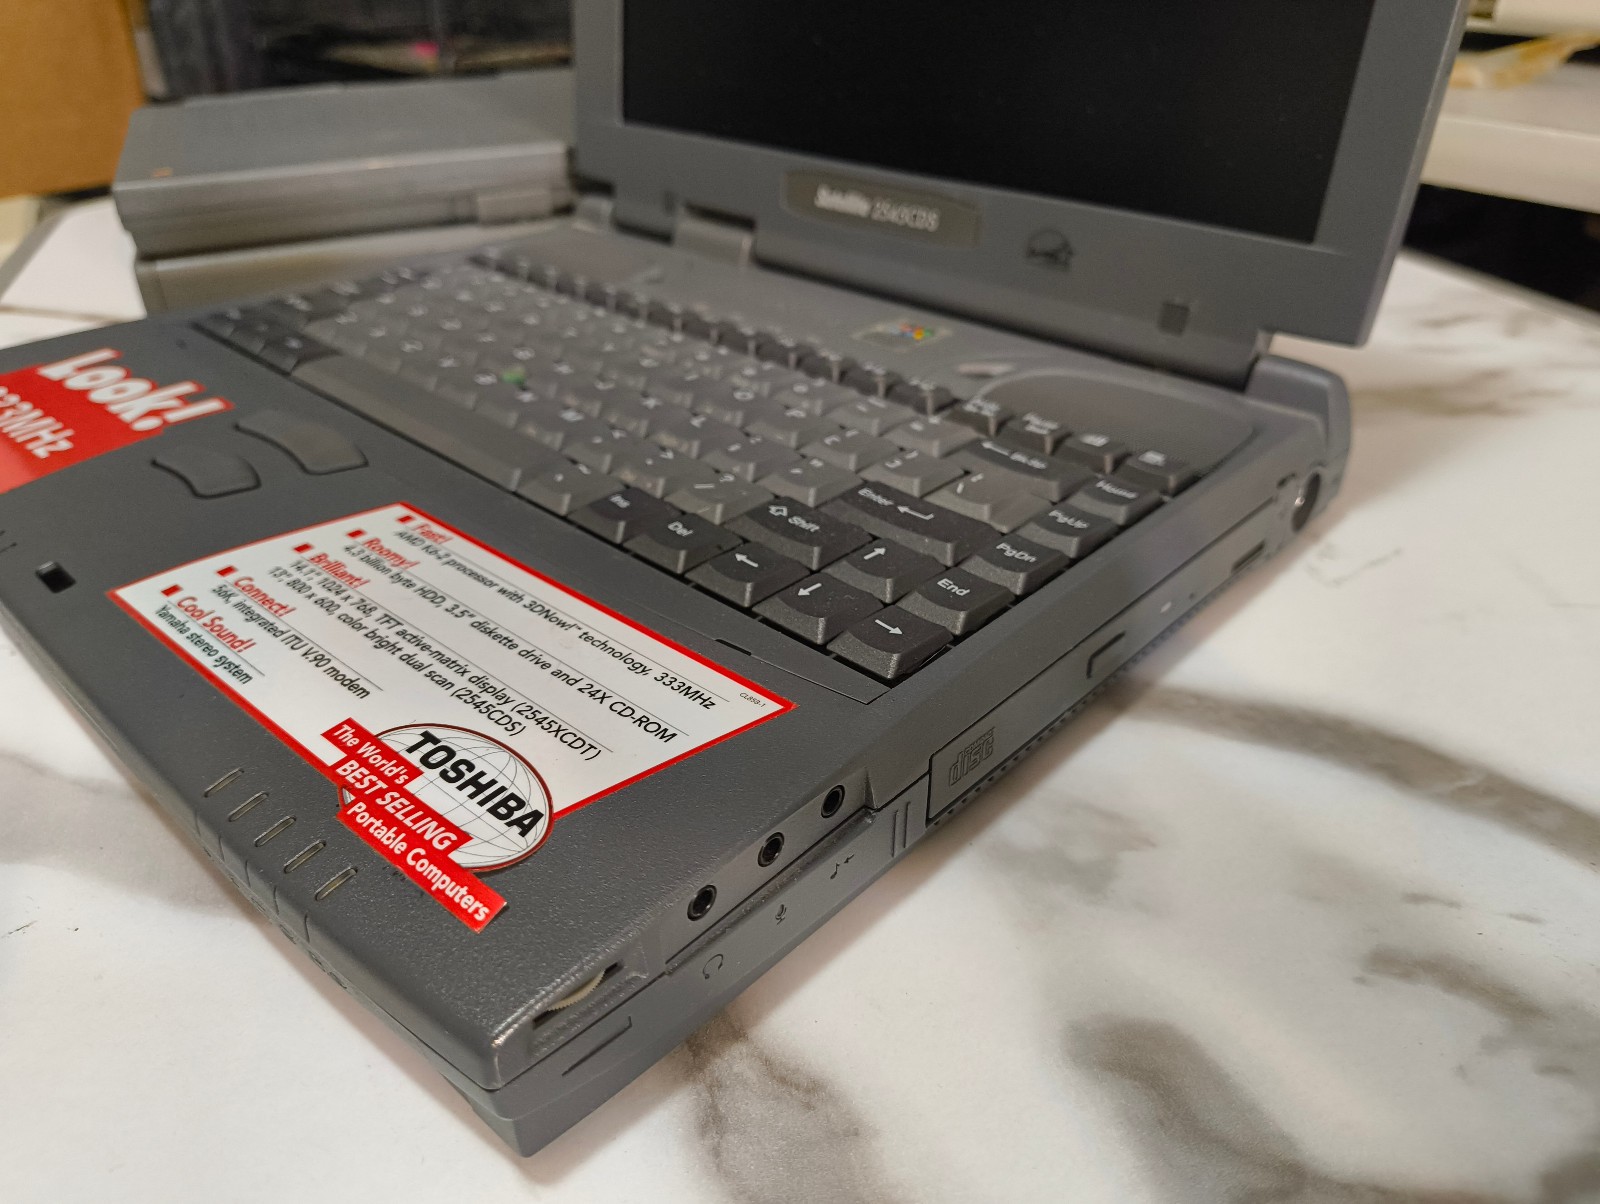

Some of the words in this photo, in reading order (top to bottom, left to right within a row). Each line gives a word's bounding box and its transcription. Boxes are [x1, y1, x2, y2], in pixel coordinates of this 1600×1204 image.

[37, 348, 227, 431] Look!
[788, 516, 820, 532] Shift
[858, 487, 894, 506] Enter
[1049, 509, 1089, 529] PgUp
[363, 537, 421, 570] Roomy!
[414, 523, 453, 543] Fast!
[667, 521, 694, 537] Del
[996, 542, 1037, 562] PgDn
[233, 576, 297, 617] Connect!
[309, 552, 371, 589] Brilliant!
[937, 578, 970, 596] End
[154, 604, 188, 635] Yamaha
[186, 630, 219, 657] stereo
[214, 653, 253, 685] system
[177, 596, 215, 621] Cool
[202, 613, 257, 654] Sound!
[232, 599, 289, 638] integrated
[280, 633, 303, 651] ITU
[300, 646, 332, 668] V.90
[323, 666, 371, 700] modem
[360, 553, 391, 576] billion
[389, 571, 416, 589] byte
[413, 585, 446, 608] HDD,
[470, 620, 519, 650] diskette
[518, 647, 552, 670] drive
[551, 668, 584, 687] and
[577, 682, 613, 704] 24X
[608, 701, 678, 744] CD-ROM
[443, 558, 499, 590] processor
[497, 585, 524, 604] with
[578, 631, 653, 676] technology,
[654, 672, 717, 710] 333MHz
[337, 612, 369, 633] color
[364, 627, 403, 656] bright
[399, 650, 433, 672] dual
[424, 669, 456, 691] scan
[450, 686, 527, 736] (2545CDS)
[375, 613, 403, 630] TFT
[396, 622, 471, 677] active-matrix
[468, 675, 515, 706] display
[511, 702, 602, 761] (2545XCDT)
[333, 724, 360, 748] The
[357, 741, 409, 785] World's
[405, 730, 545, 838] TOSHIBA
[335, 760, 388, 795] BEST
[375, 791, 458, 851] SELLING
[347, 802, 408, 855] Portable
[406, 848, 491, 922] Computers
